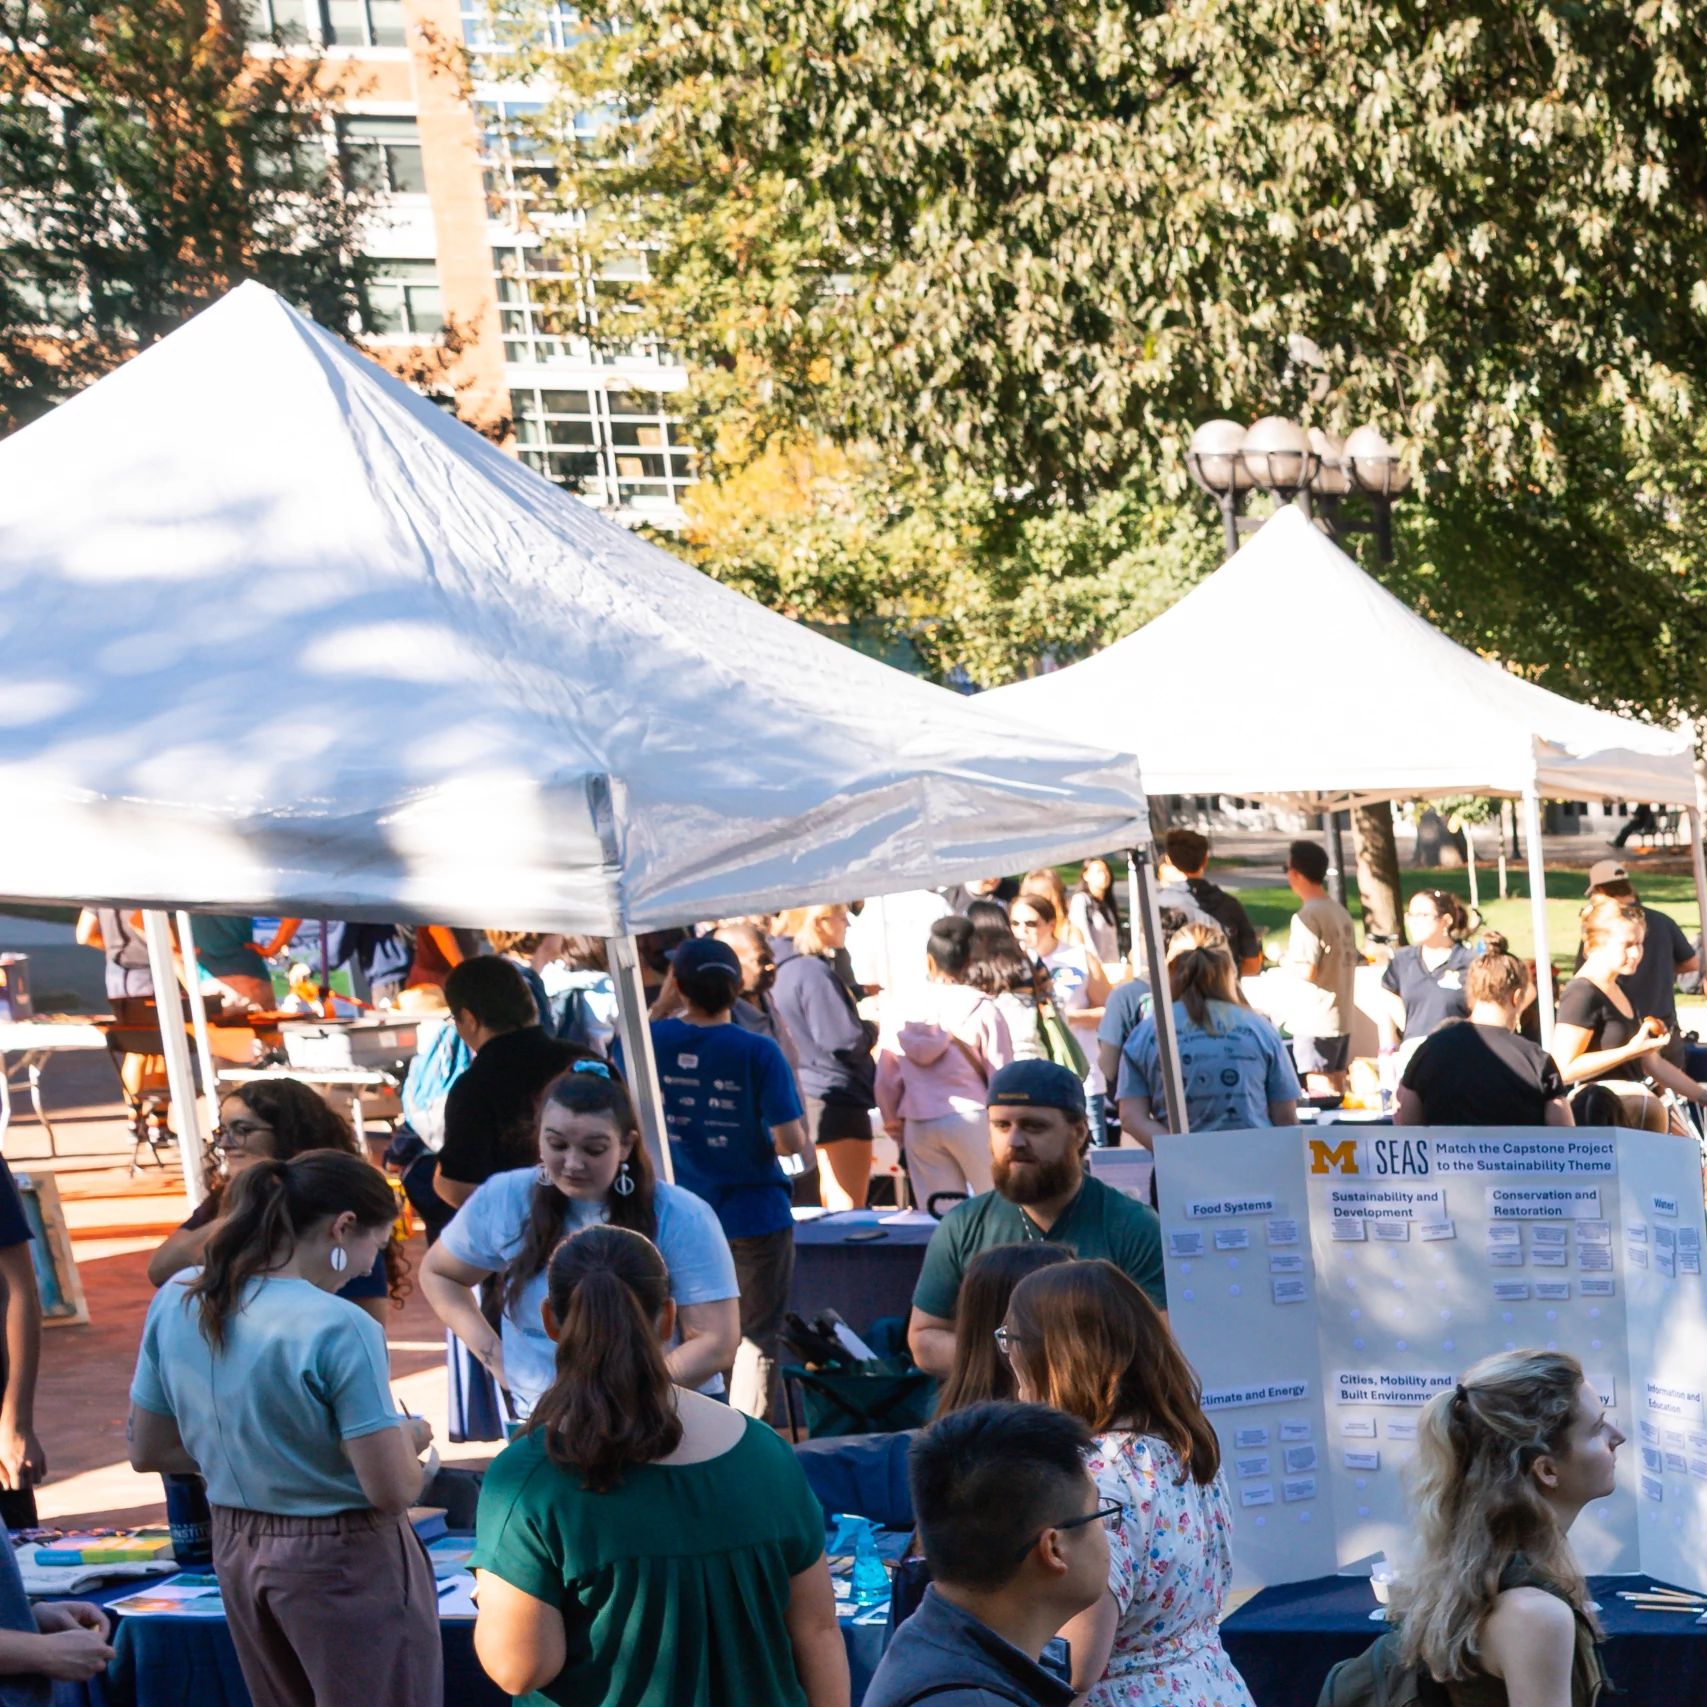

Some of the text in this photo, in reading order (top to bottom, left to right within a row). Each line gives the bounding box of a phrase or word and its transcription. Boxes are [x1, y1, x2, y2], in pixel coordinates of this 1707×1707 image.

[1309, 1140, 1614, 1175] M SEAS Match the Capstone Project
[1437, 1160, 1611, 1173] to the Sustainability Theme
[1332, 1191, 1438, 1204] Sustainability and
[1493, 1190, 1597, 1200] Conservation and
[1193, 1200, 1273, 1216] Food Systems
[1494, 1206, 1562, 1216] Restoration
[1654, 1198, 1675, 1211] Water
[1334, 1207, 1413, 1219] Development
[1340, 1375, 1452, 1390] Cities, Mobility and
[1245, 1389, 1266, 1401] and
[1268, 1385, 1305, 1400] Energy
[1341, 1390, 1433, 1402] Built Environme
